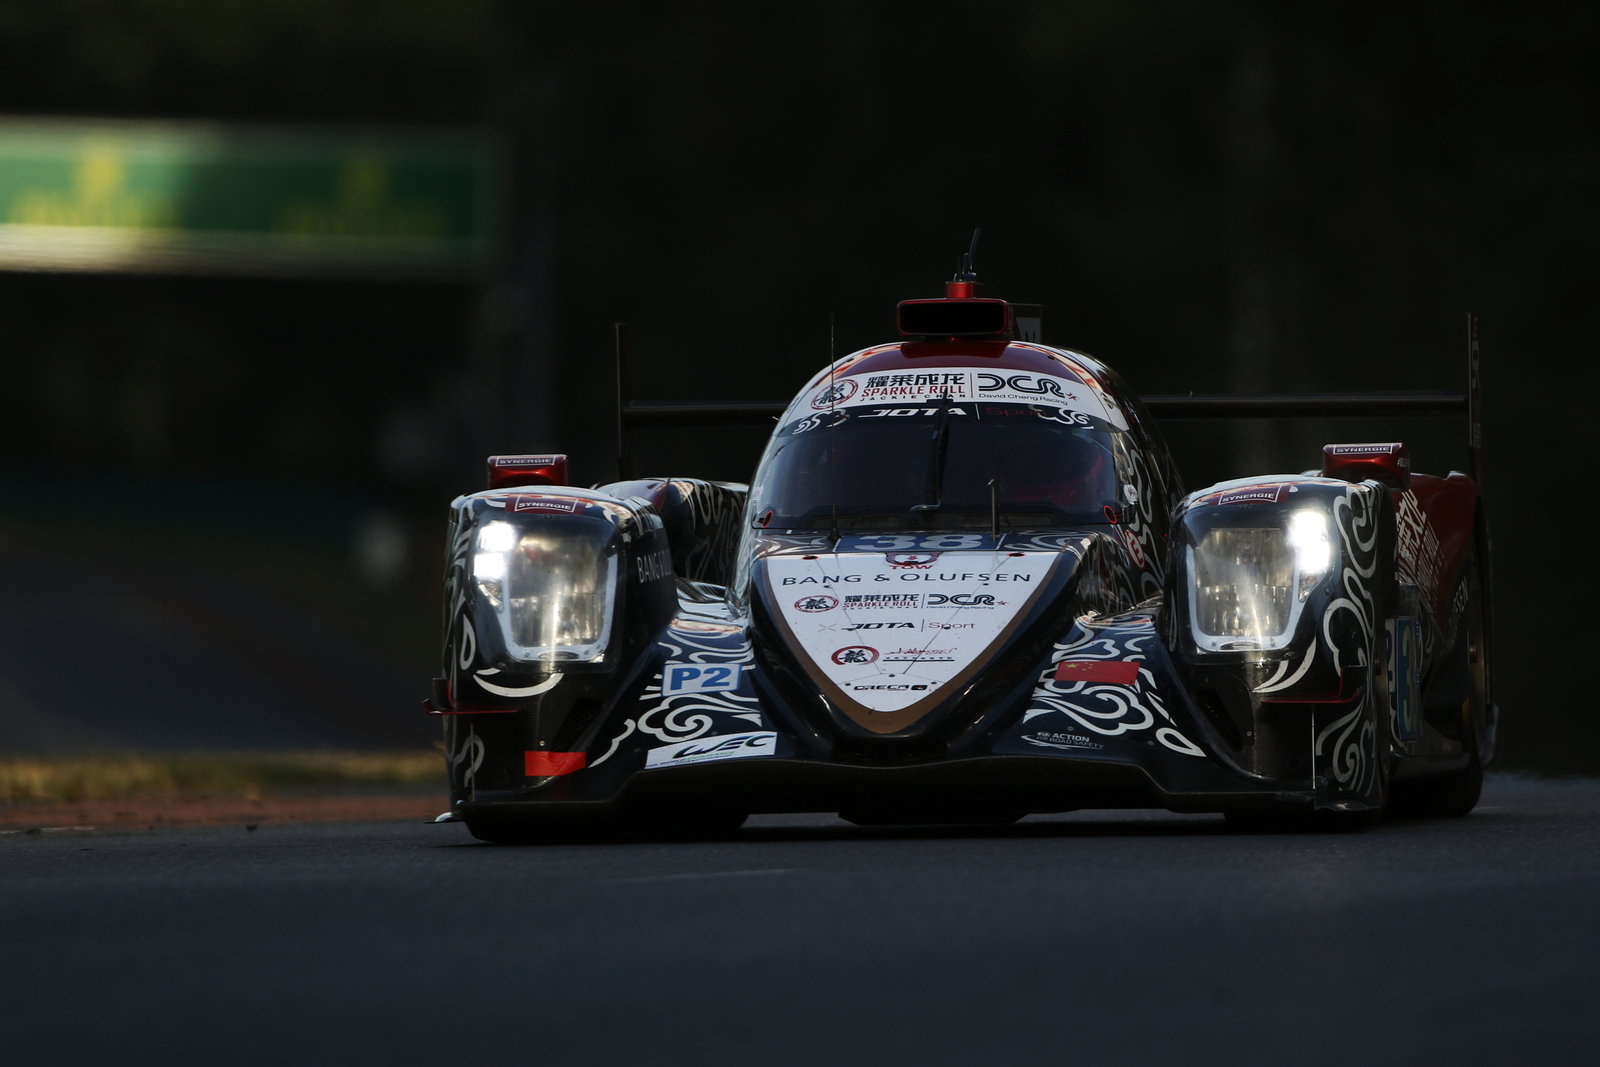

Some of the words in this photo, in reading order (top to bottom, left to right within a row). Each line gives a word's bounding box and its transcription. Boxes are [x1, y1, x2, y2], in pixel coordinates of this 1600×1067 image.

[865, 373, 965, 388] 耀莱成龙
[861, 386, 925, 397] SPARKLE
[929, 385, 965, 394] ROLL
[1007, 394, 1039, 402] Cheng
[1039, 396, 1068, 406] Racing
[858, 407, 967, 417] JOTA
[499, 457, 552, 465] SYNERGIE
[1222, 492, 1276, 503] SYNERGIE
[518, 501, 573, 511] SYNERGIE
[854, 535, 983, 550] 38
[782, 574, 862, 586] BANG
[874, 573, 890, 582] &
[900, 573, 1031, 582] OLUFSEN
[841, 622, 915, 631] JOTA
[928, 621, 976, 630] Sport
[670, 667, 732, 691] P2
[1052, 732, 1090, 743] ACTION
